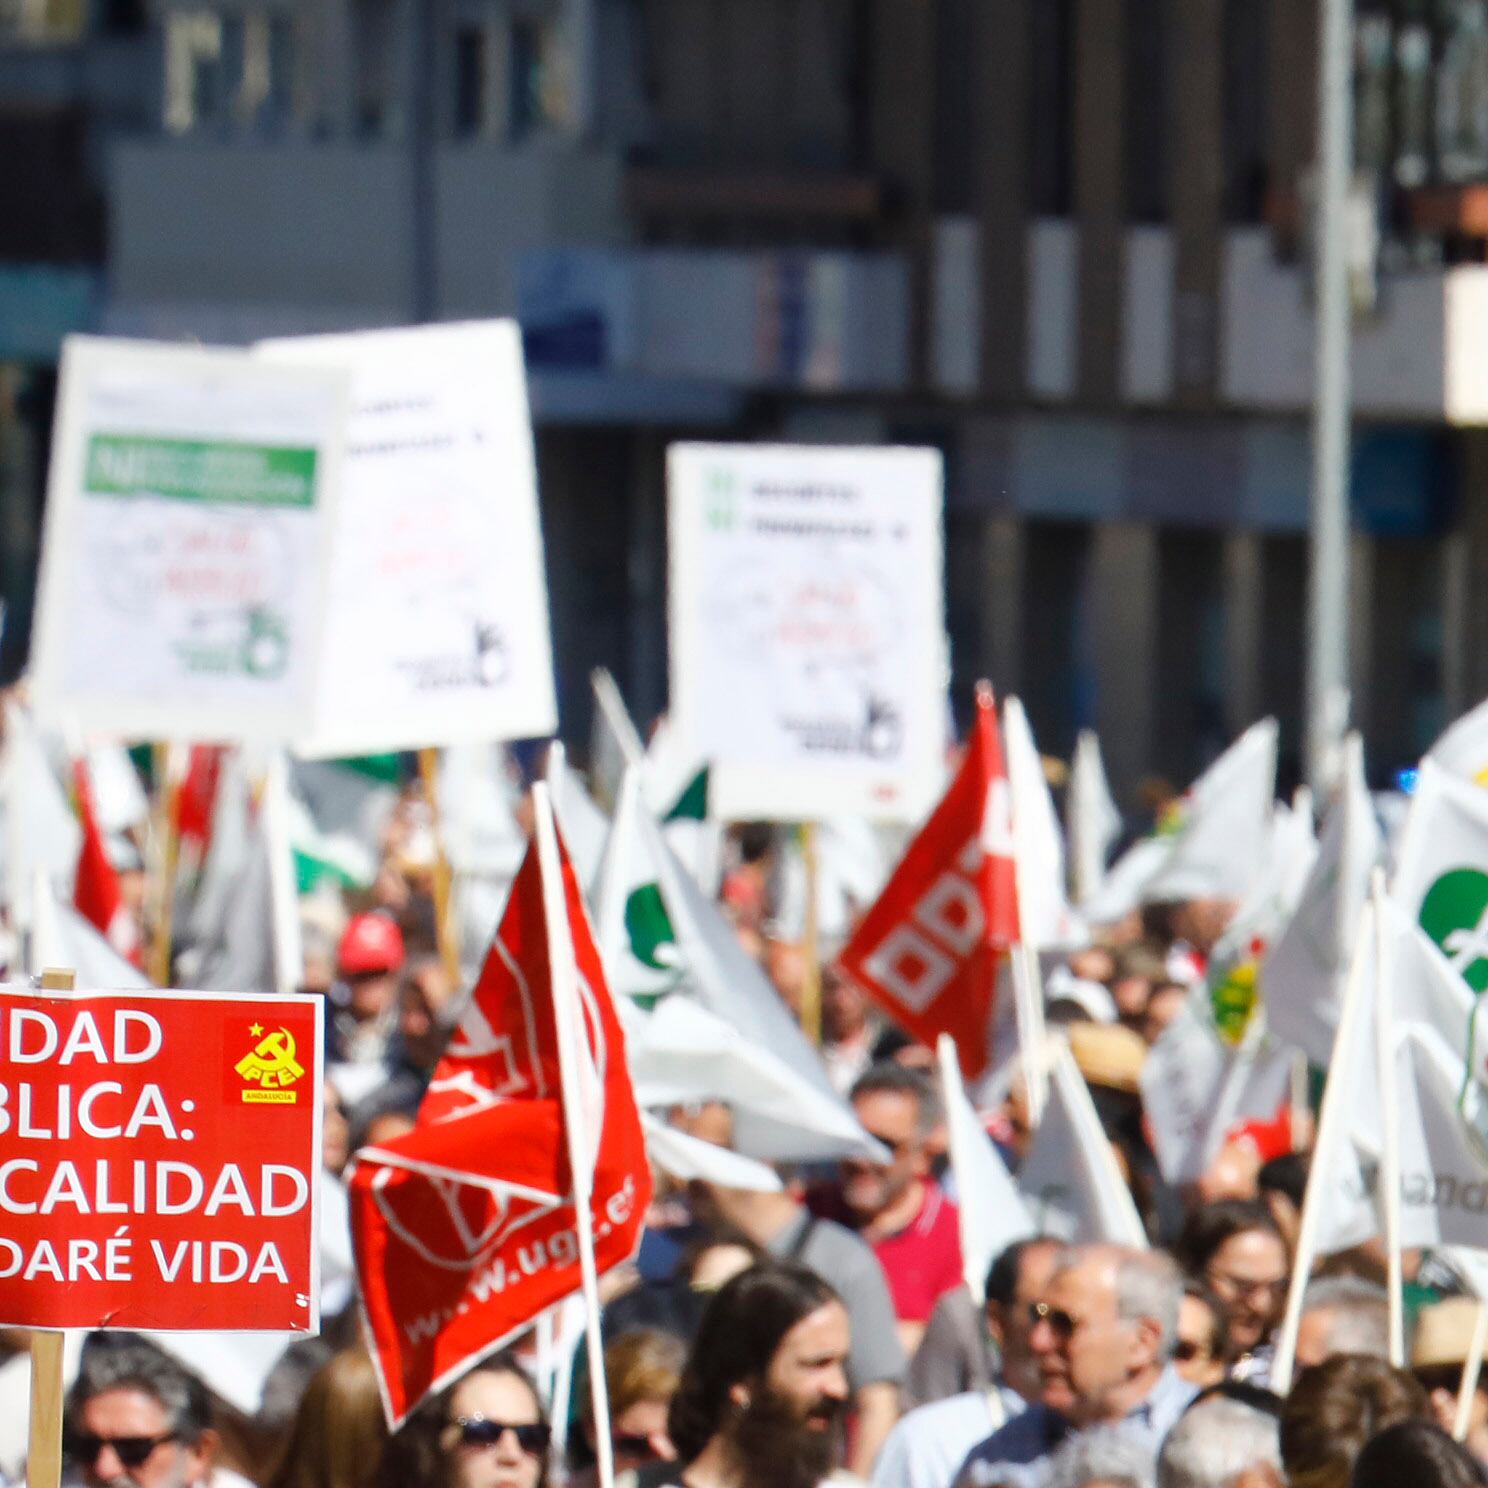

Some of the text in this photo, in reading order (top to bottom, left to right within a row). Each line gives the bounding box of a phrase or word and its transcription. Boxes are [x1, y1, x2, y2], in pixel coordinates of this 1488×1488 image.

[0, 1081, 195, 1141] LICA:
[0, 1158, 309, 1217] CALIDAD
[150, 1239, 289, 1284] VIDA
